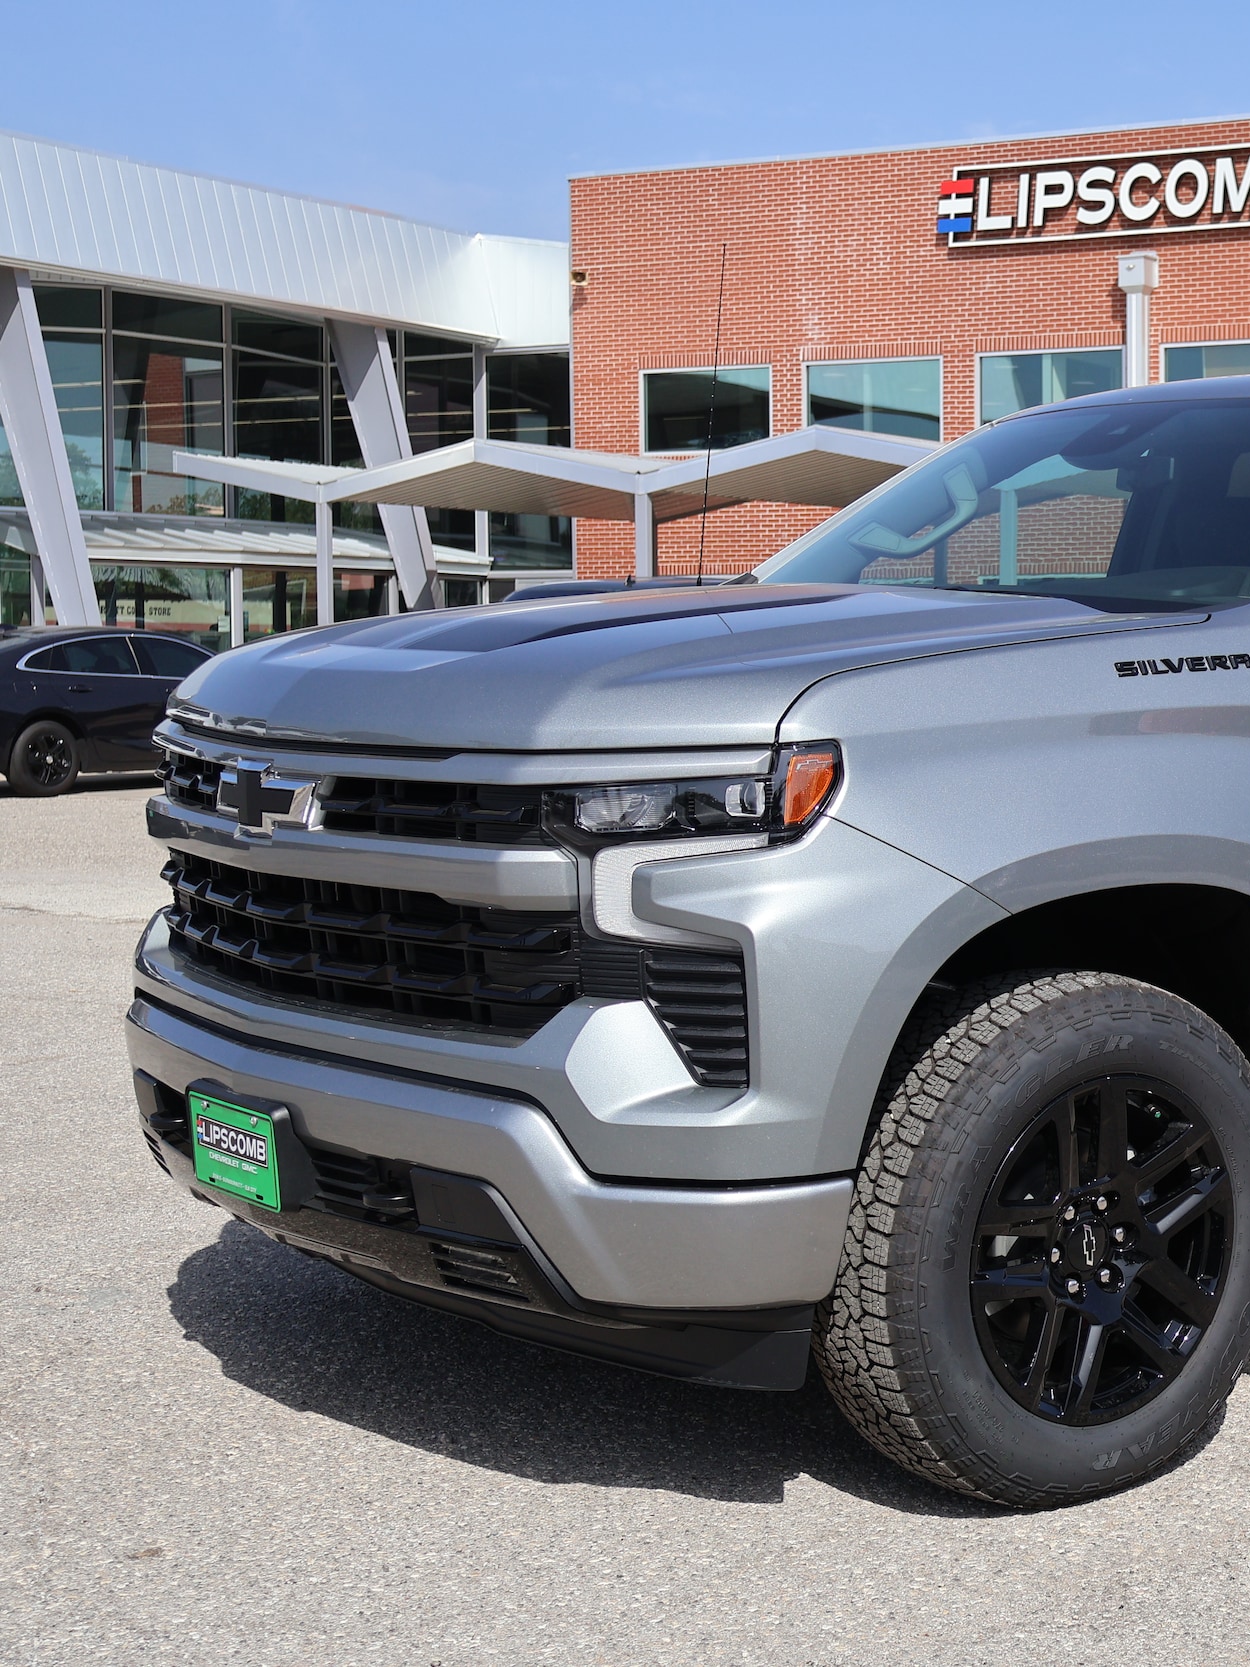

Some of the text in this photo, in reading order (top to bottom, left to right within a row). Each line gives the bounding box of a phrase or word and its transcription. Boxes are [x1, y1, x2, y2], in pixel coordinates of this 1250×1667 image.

[148, 606, 172, 617] STORE
[202, 1121, 266, 1161] LIPSCOMB
[208, 1151, 258, 1174] CHEVROLET GMC
